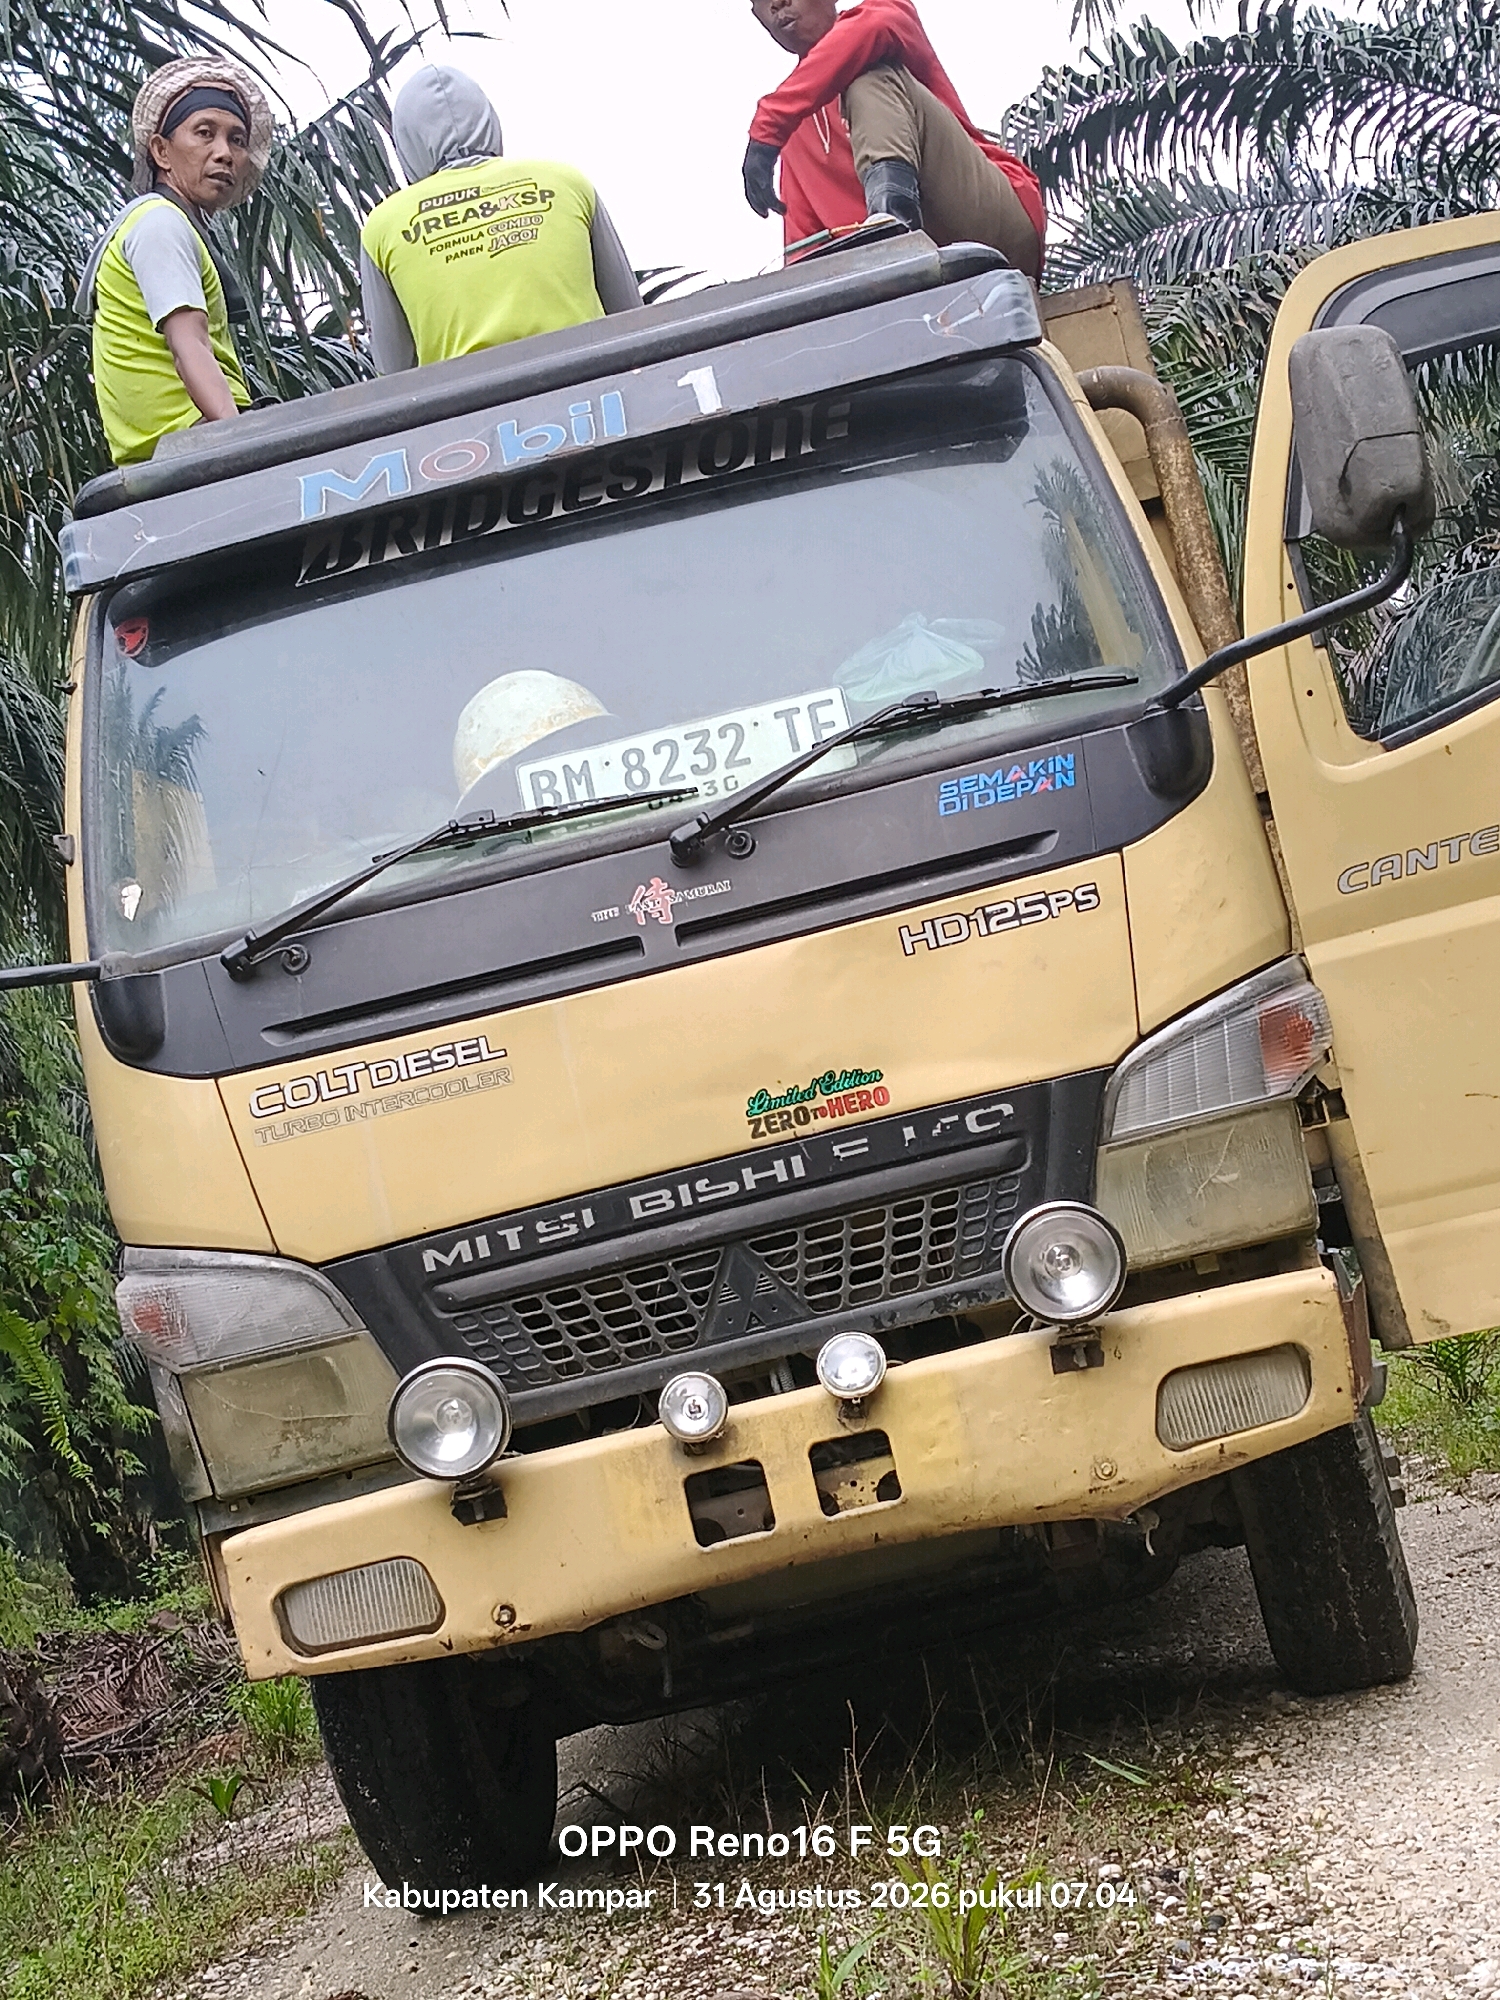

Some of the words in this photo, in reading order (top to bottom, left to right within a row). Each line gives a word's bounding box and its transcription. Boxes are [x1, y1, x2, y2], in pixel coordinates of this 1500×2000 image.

[420, 188, 479, 211] PUPUK
[429, 231, 485, 255] FORMULA
[487, 215, 543, 236] COMBO
[445, 244, 483, 263] PANEN
[488, 228, 538, 251] JAGO!
[299, 390, 628, 523] Mobil
[677, 365, 724, 415] 1
[295, 401, 851, 587] BRIDGESTONE
[530, 760, 596, 808] BM
[621, 723, 751, 792] 8232
[973, 771, 1075, 809] DEPAN
[668, 880, 732, 904] SAMURAI
[899, 882, 1100, 957] HD125PS
[255, 1110, 341, 1144] TURBO
[344, 1066, 512, 1122] INTERCOOLER
[746, 1079, 817, 1117] Limited
[818, 1068, 884, 1096] Edition
[747, 1105, 811, 1139] ZERO
[826, 1086, 891, 1119] HERO
